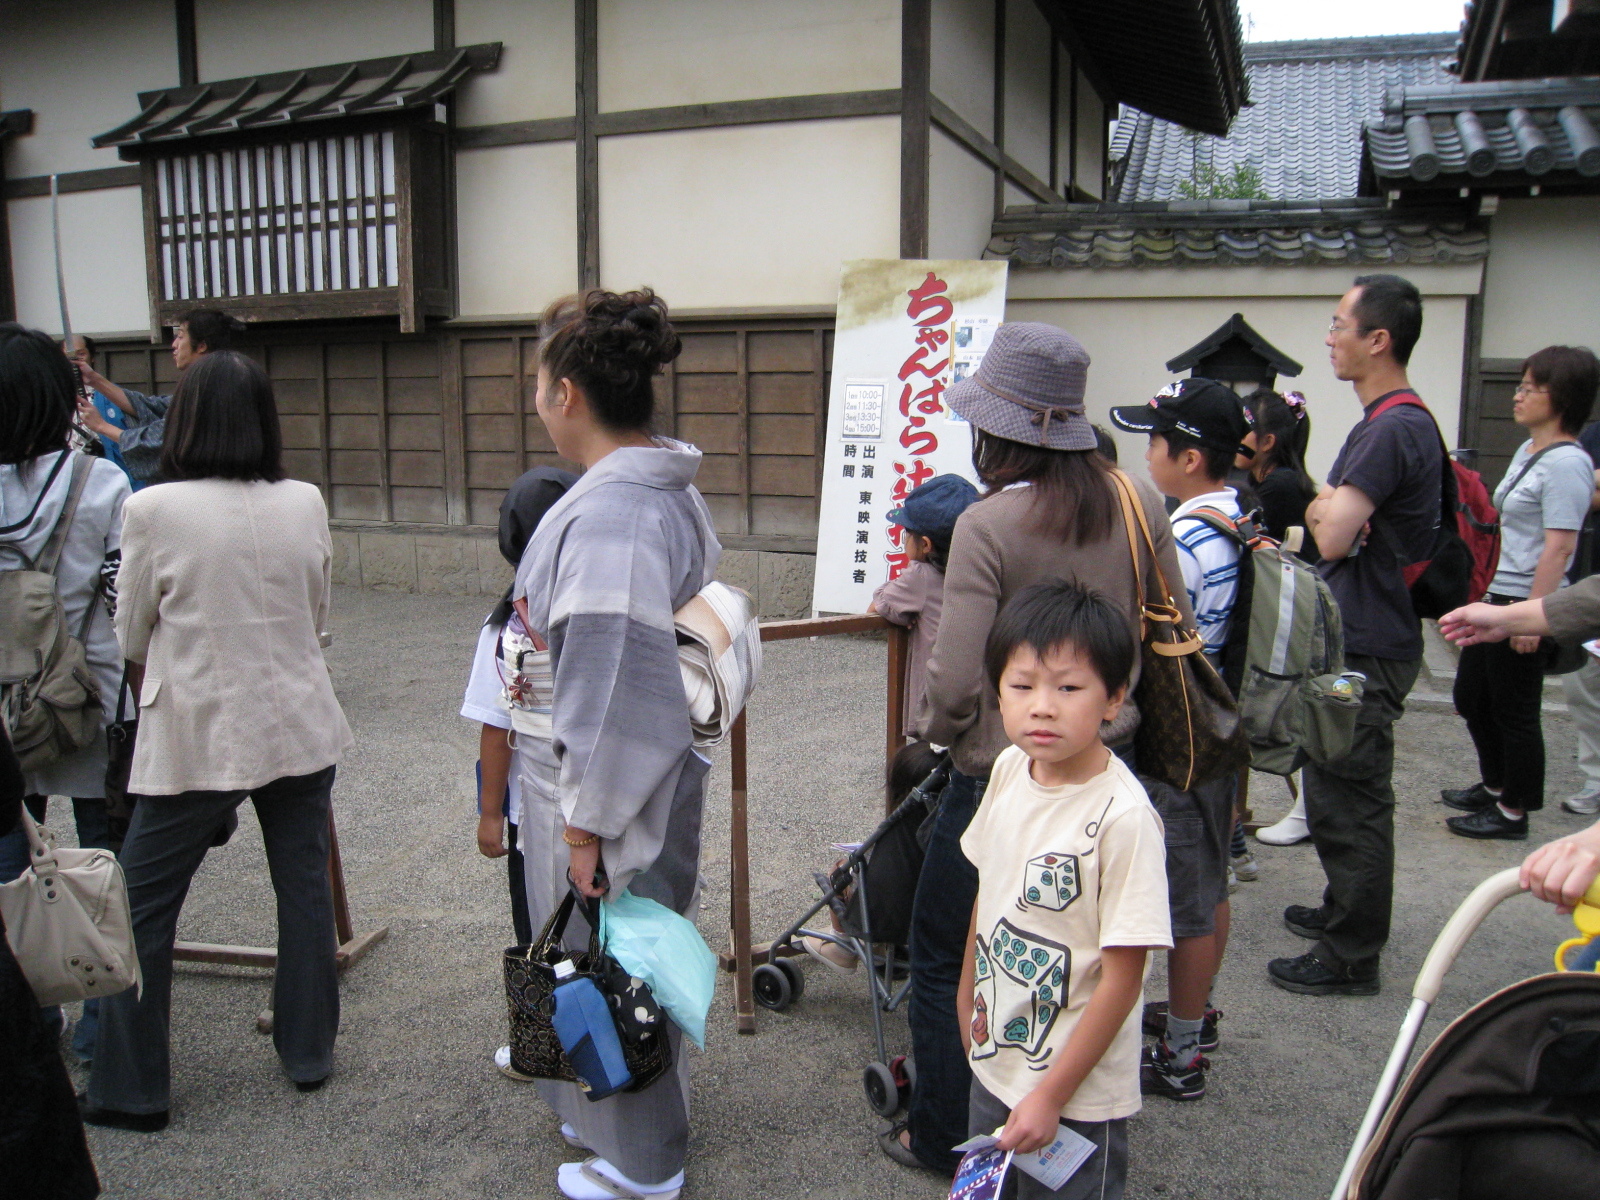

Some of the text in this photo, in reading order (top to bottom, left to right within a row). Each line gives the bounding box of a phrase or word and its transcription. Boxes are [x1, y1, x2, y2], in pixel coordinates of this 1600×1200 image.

[842, 444, 857, 478] 時間
[852, 445, 876, 584] 出演 東映演技者
